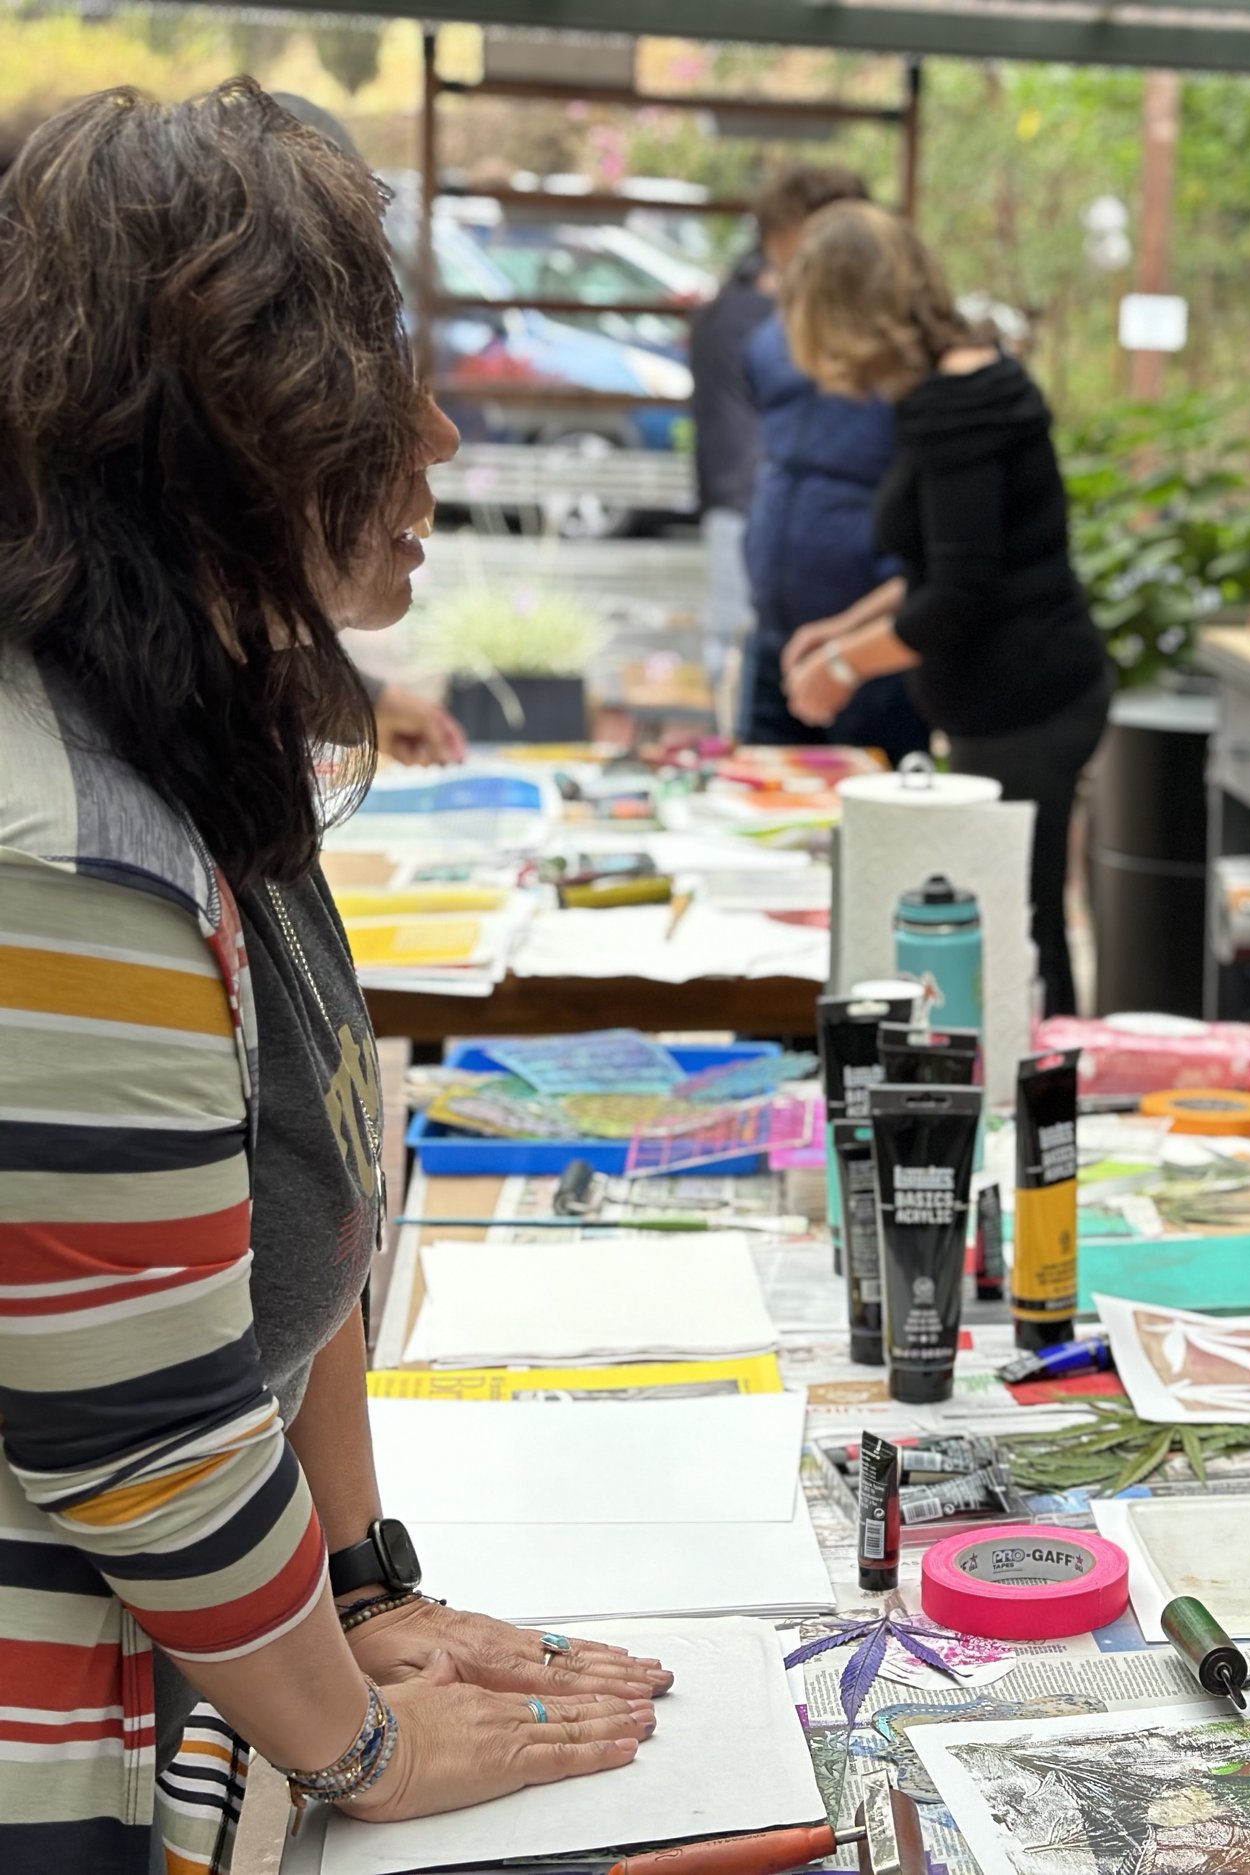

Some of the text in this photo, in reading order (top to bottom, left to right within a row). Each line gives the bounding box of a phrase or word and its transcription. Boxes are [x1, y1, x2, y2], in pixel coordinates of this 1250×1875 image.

[894, 1191, 954, 1208] BASICS
[895, 1208, 953, 1224] ACRYLIC
[992, 1562, 1015, 1570] TAPES
